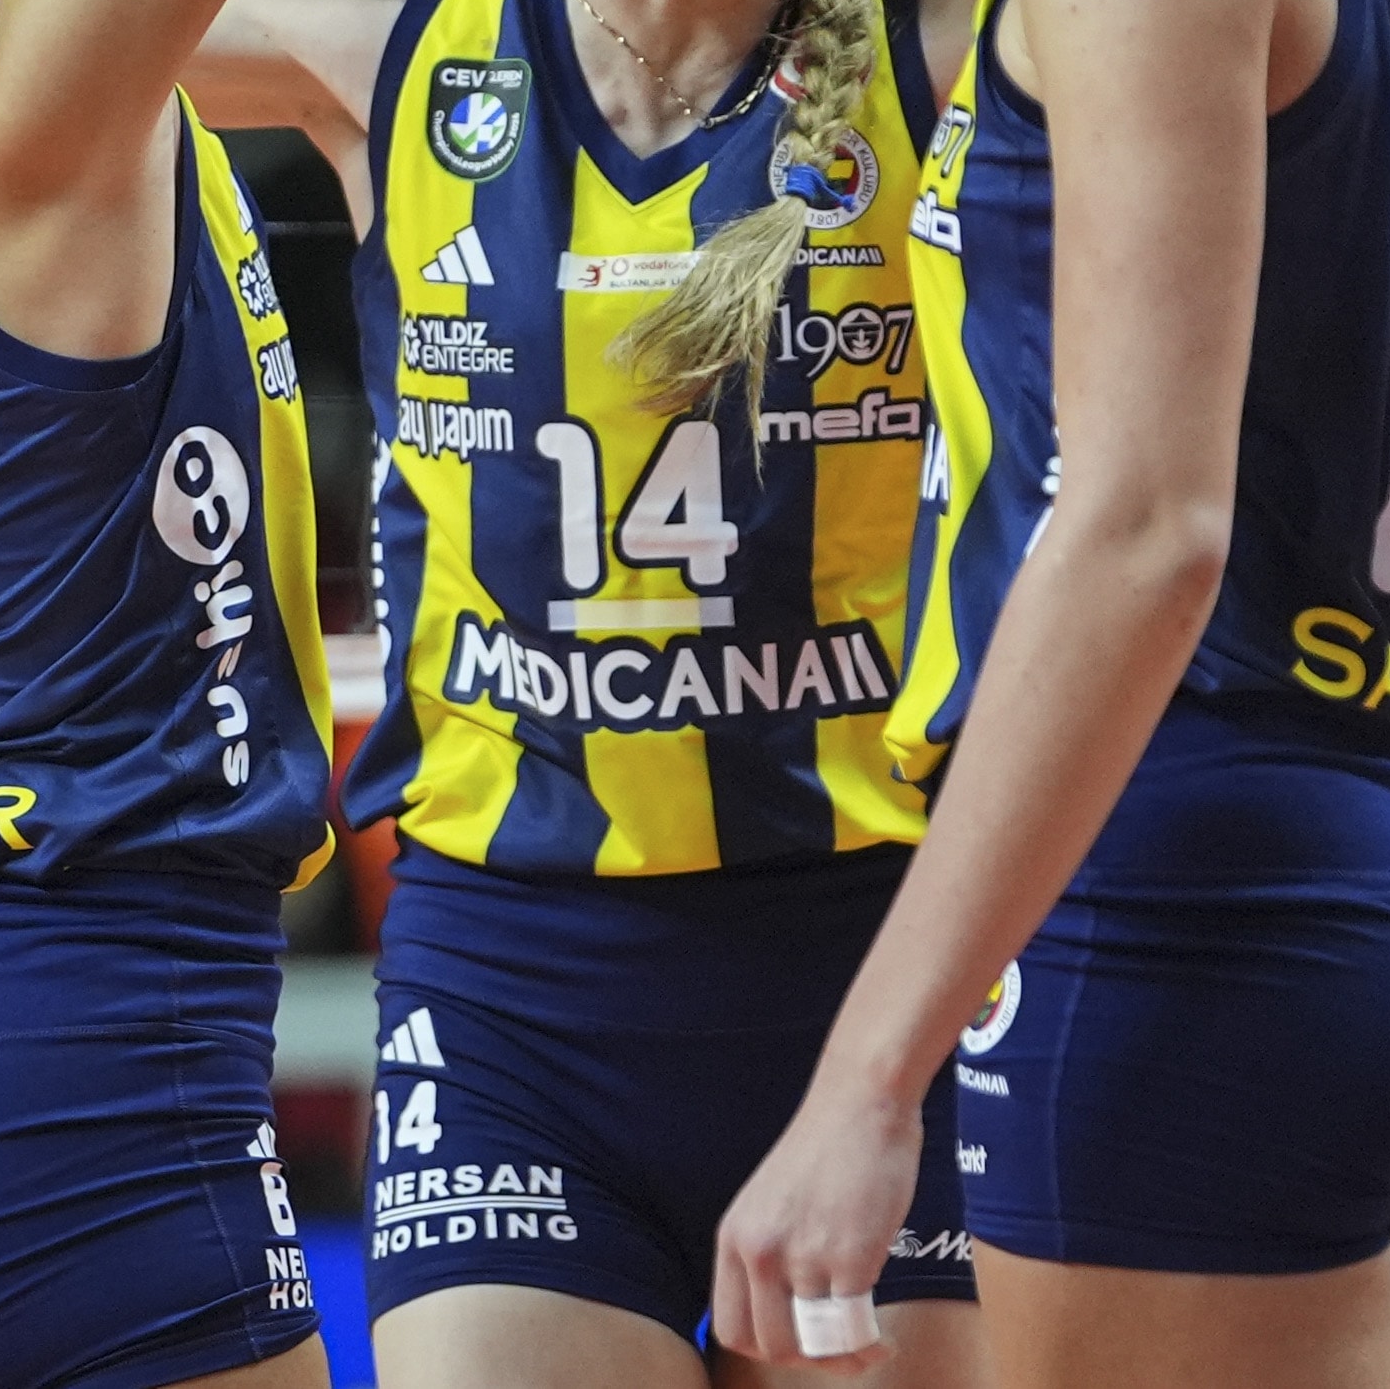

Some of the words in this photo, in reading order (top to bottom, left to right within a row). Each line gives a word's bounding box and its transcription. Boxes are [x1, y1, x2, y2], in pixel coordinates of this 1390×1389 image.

[440, 67, 487, 88] CEV
[419, 319, 488, 347] YILDIZ
[422, 344, 515, 374] ENTEGRE
[536, 420, 739, 590] 14
[375, 1080, 443, 1165] 14
[260, 1161, 297, 1237] 8
[375, 1163, 563, 1212] NERSAN
